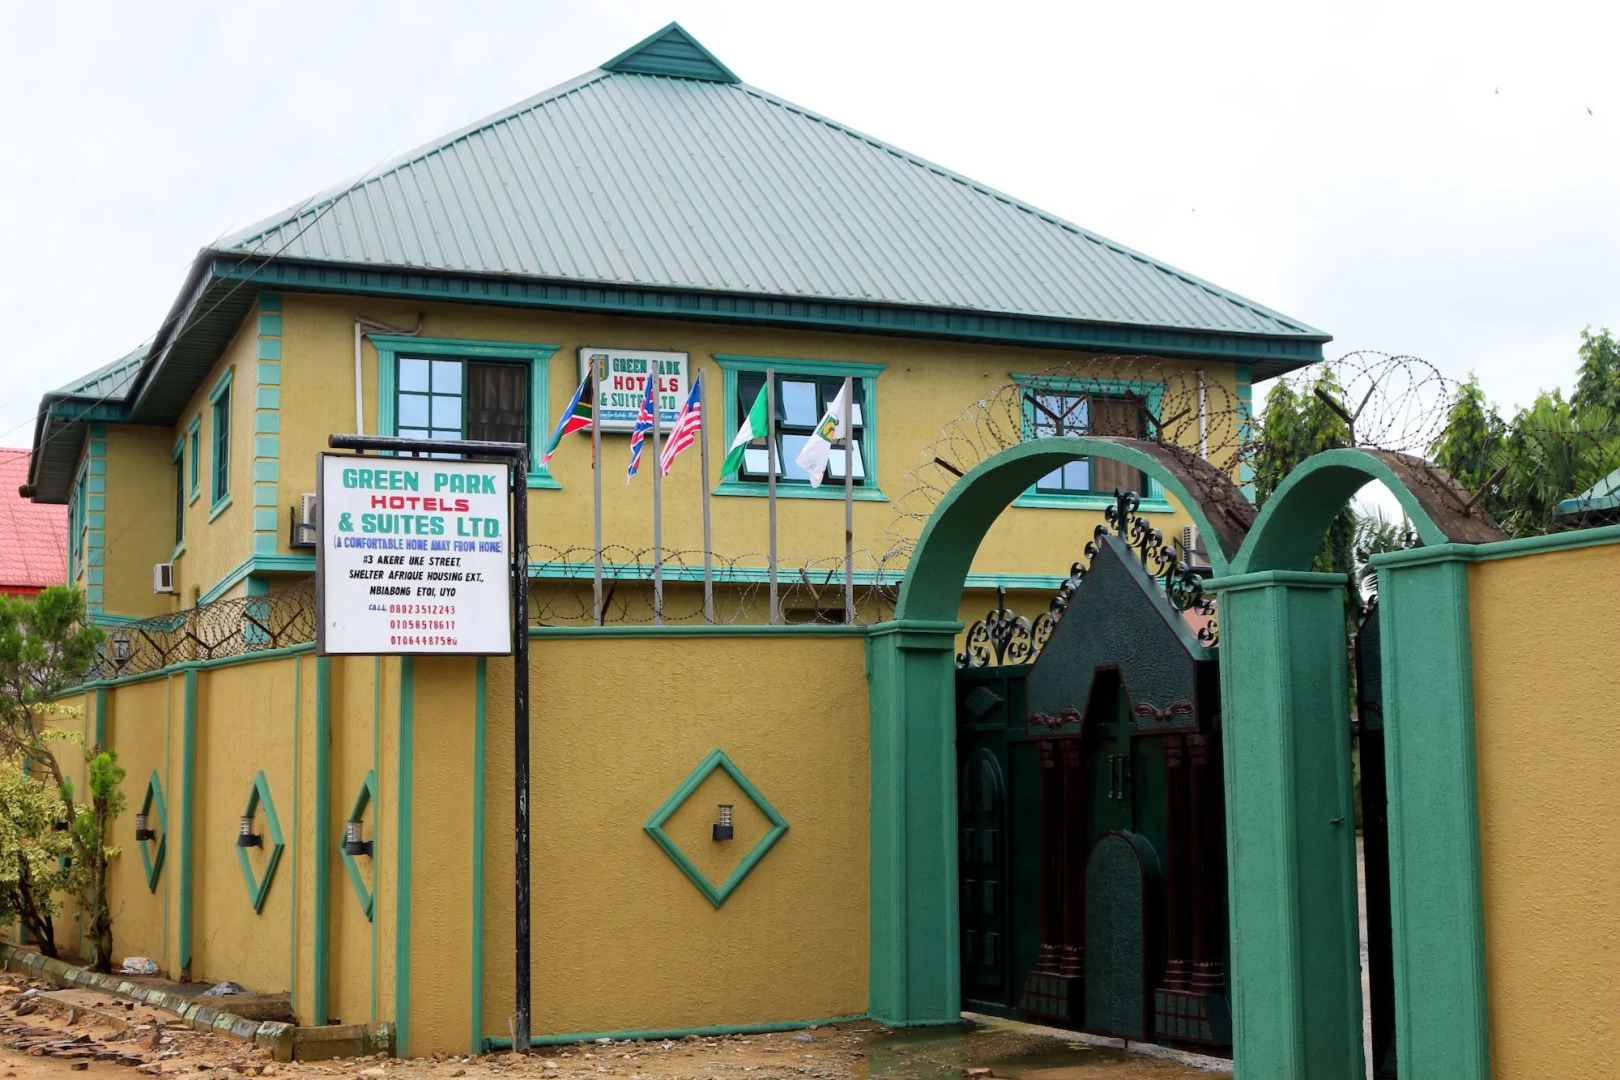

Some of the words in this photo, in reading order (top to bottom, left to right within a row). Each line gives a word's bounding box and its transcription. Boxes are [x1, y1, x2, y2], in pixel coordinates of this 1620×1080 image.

[613, 358, 647, 373] GREEN
[652, 360, 680, 375] ARK
[613, 375, 679, 392] HOTLS
[600, 392, 608, 406] &
[611, 392, 644, 408] SUITE
[343, 468, 419, 492] GREEN
[434, 472, 497, 495] PARK
[371, 495, 470, 513] HOTELS
[338, 512, 355, 532] &
[361, 513, 445, 536] SUITES
[344, 536, 404, 550] COMFORTABLE
[406, 538, 428, 551] HOME
[430, 540, 451, 552] AWAY
[453, 541, 476, 552] FROM
[377, 555, 405, 565] AKERE
[408, 556, 425, 566] UKE
[349, 569, 384, 580] SHELTER
[388, 570, 424, 580] AFRIQUE
[427, 571, 463, 582] HOUSING
[369, 586, 411, 596] MBIABONG
[439, 587, 456, 597] UYO
[389, 604, 456, 615] 08023512243
[390, 620, 456, 630] 07058578617
